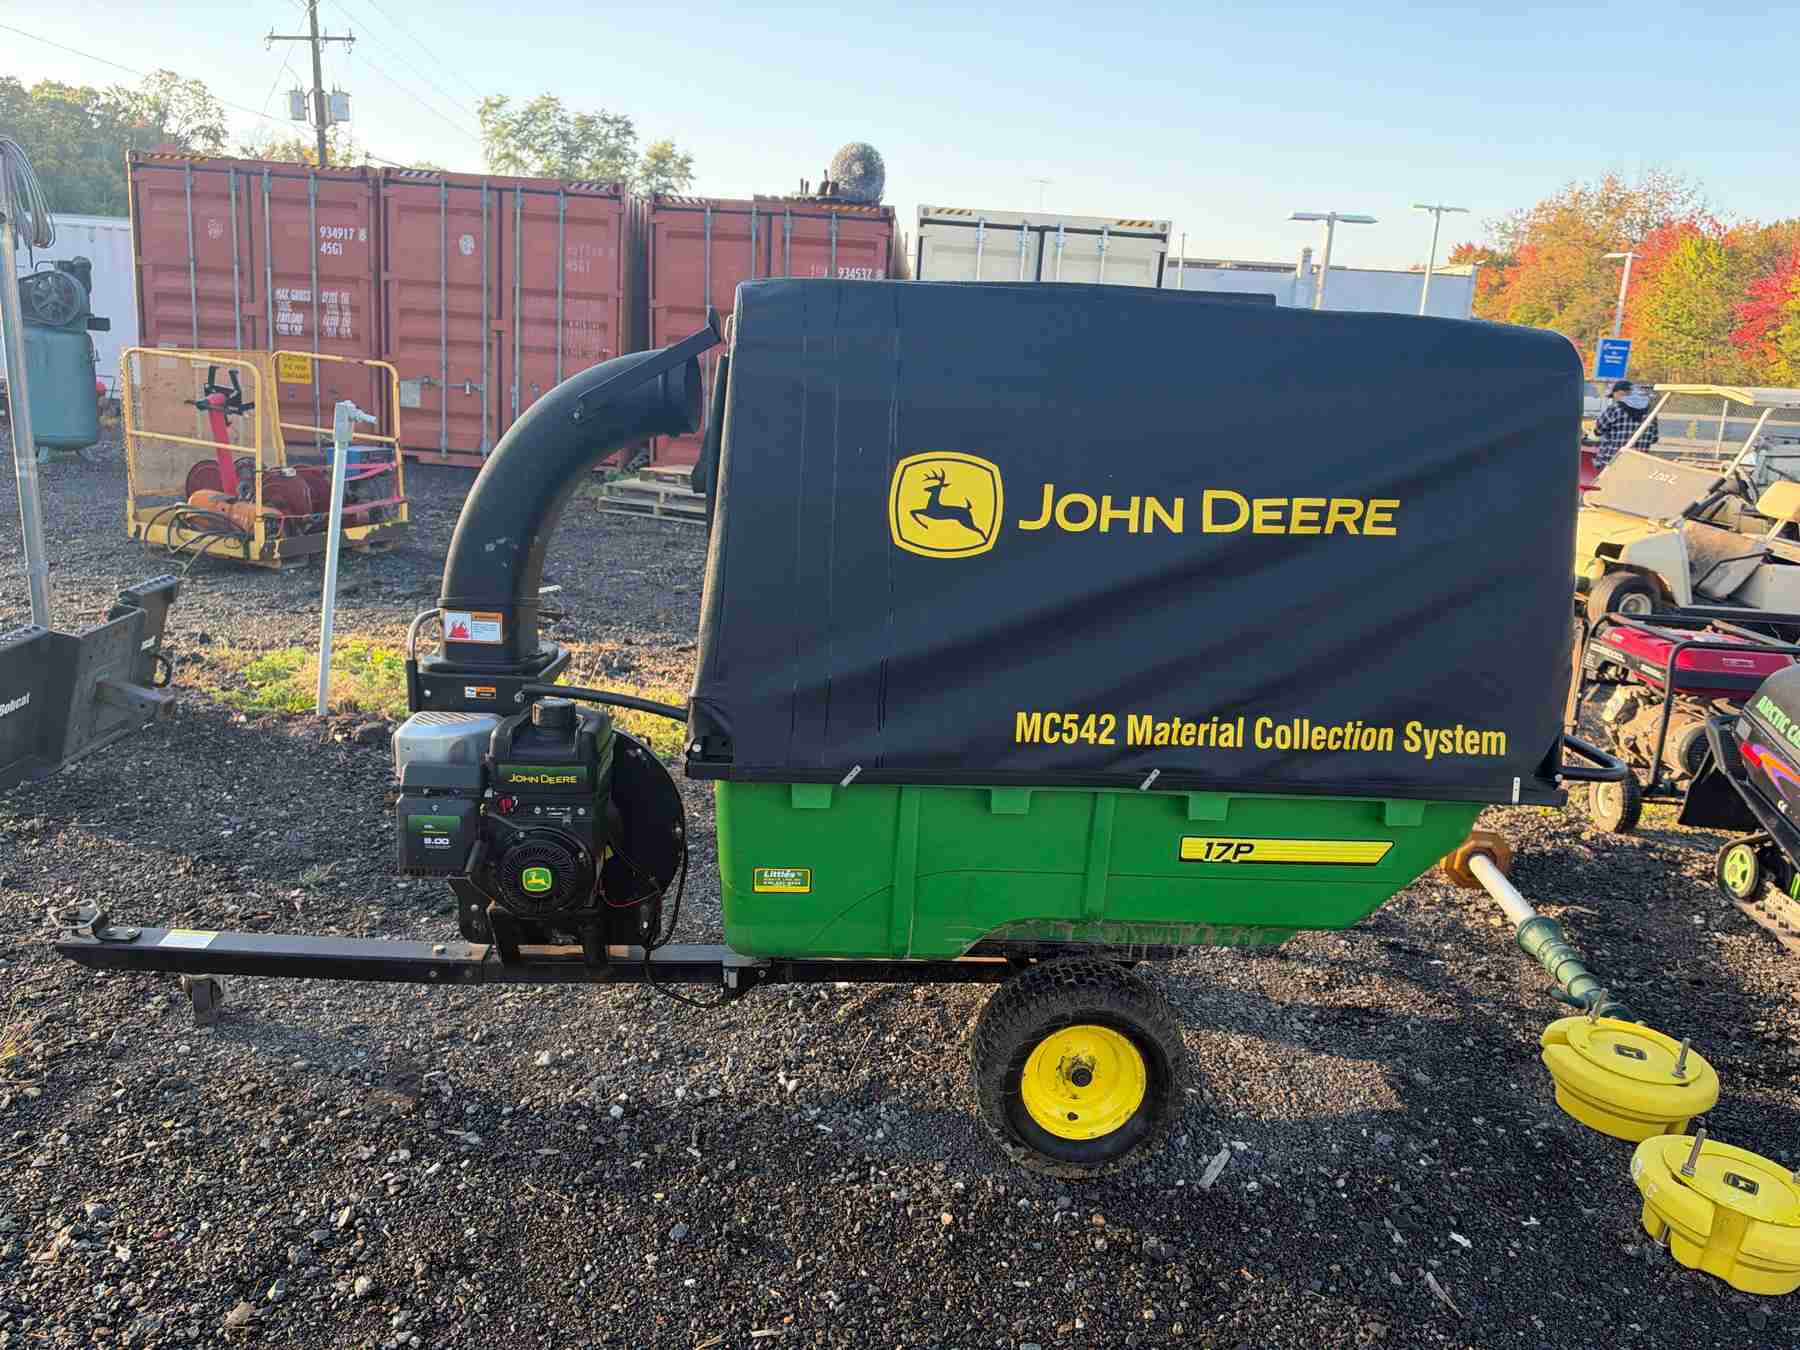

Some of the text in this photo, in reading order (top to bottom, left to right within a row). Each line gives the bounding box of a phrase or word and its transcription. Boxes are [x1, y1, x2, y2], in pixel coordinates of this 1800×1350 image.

[320, 226, 354, 240] 934917
[1018, 483, 1401, 537] JOHN DEERE
[1757, 695, 1791, 734] ARCTIC
[1015, 711, 1507, 760] MC542 Material Collection System
[508, 773, 577, 785] JOHN DEERE
[1204, 841, 1255, 860] 17P
